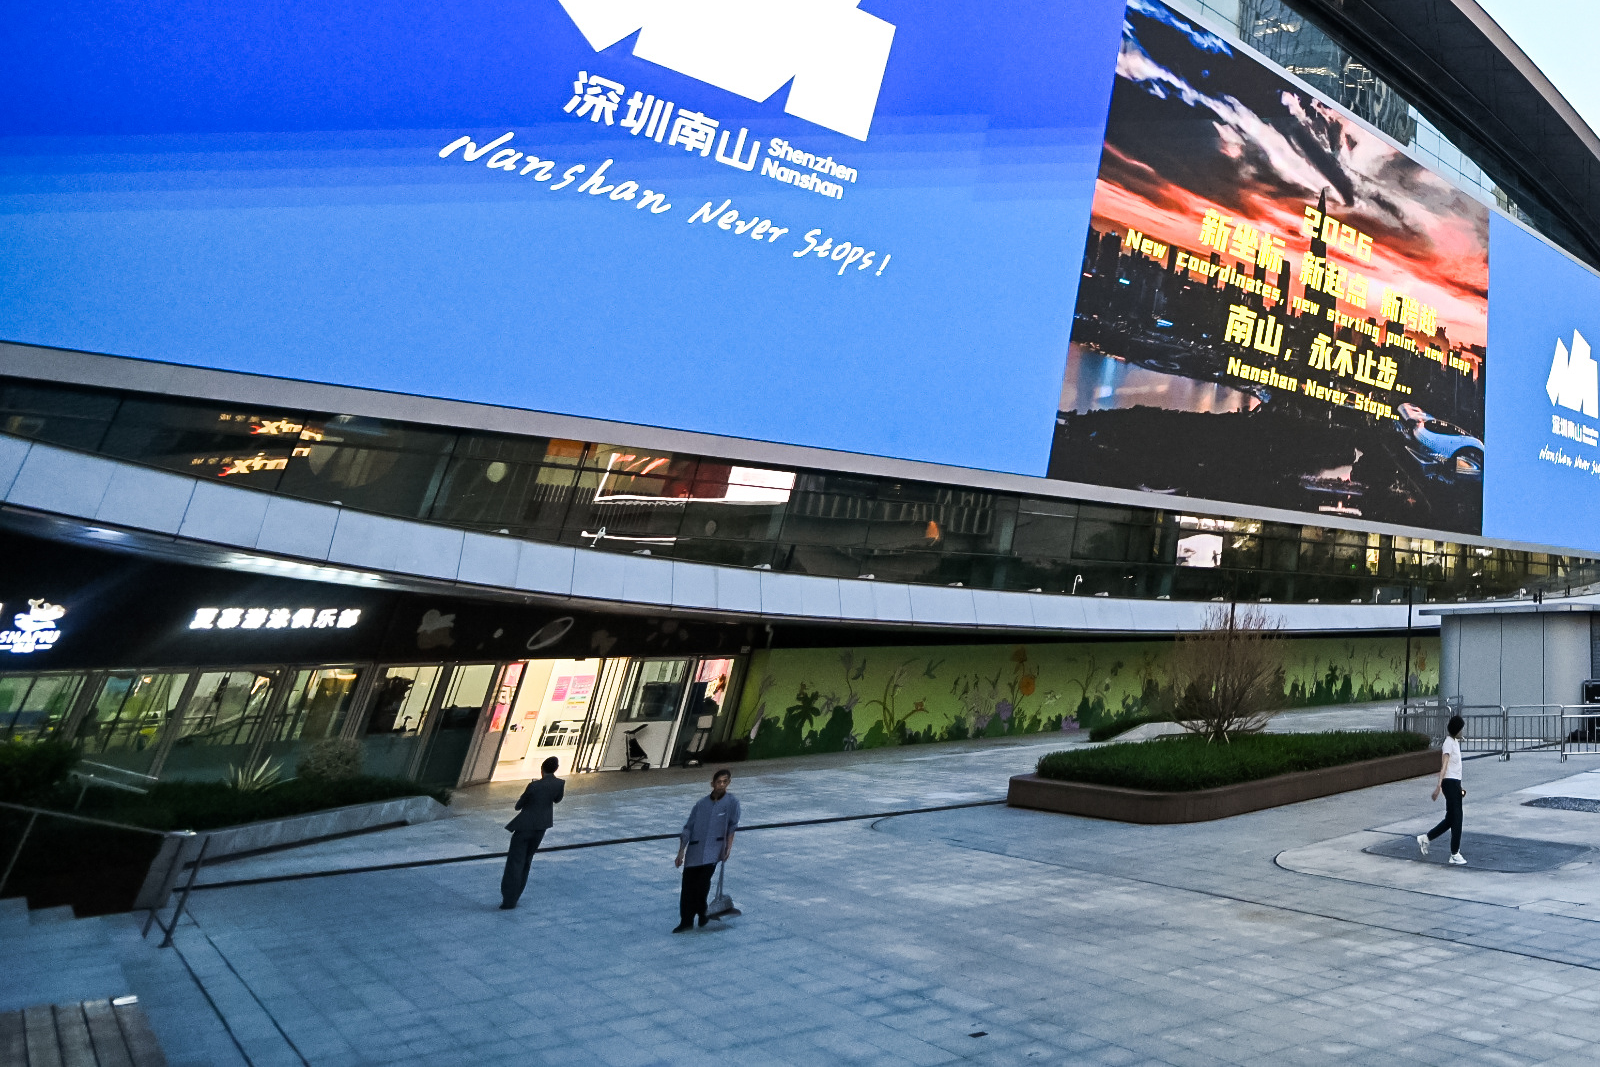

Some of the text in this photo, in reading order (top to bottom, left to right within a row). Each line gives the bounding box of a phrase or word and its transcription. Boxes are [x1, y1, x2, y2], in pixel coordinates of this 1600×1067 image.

[563, 70, 761, 172] 深圳南山
[767, 137, 858, 184] Shenzhen
[439, 132, 672, 215] Nanshan
[687, 199, 789, 243] Never
[761, 163, 844, 200] Nanshan
[1199, 207, 1437, 337] 新坐标 新起点 新跨越
[1302, 206, 1374, 263] 2026
[1125, 228, 1471, 377] New coordinates, new starting point, new leap
[1226, 356, 1298, 392] Nanshan
[1304, 378, 1349, 406] Never
